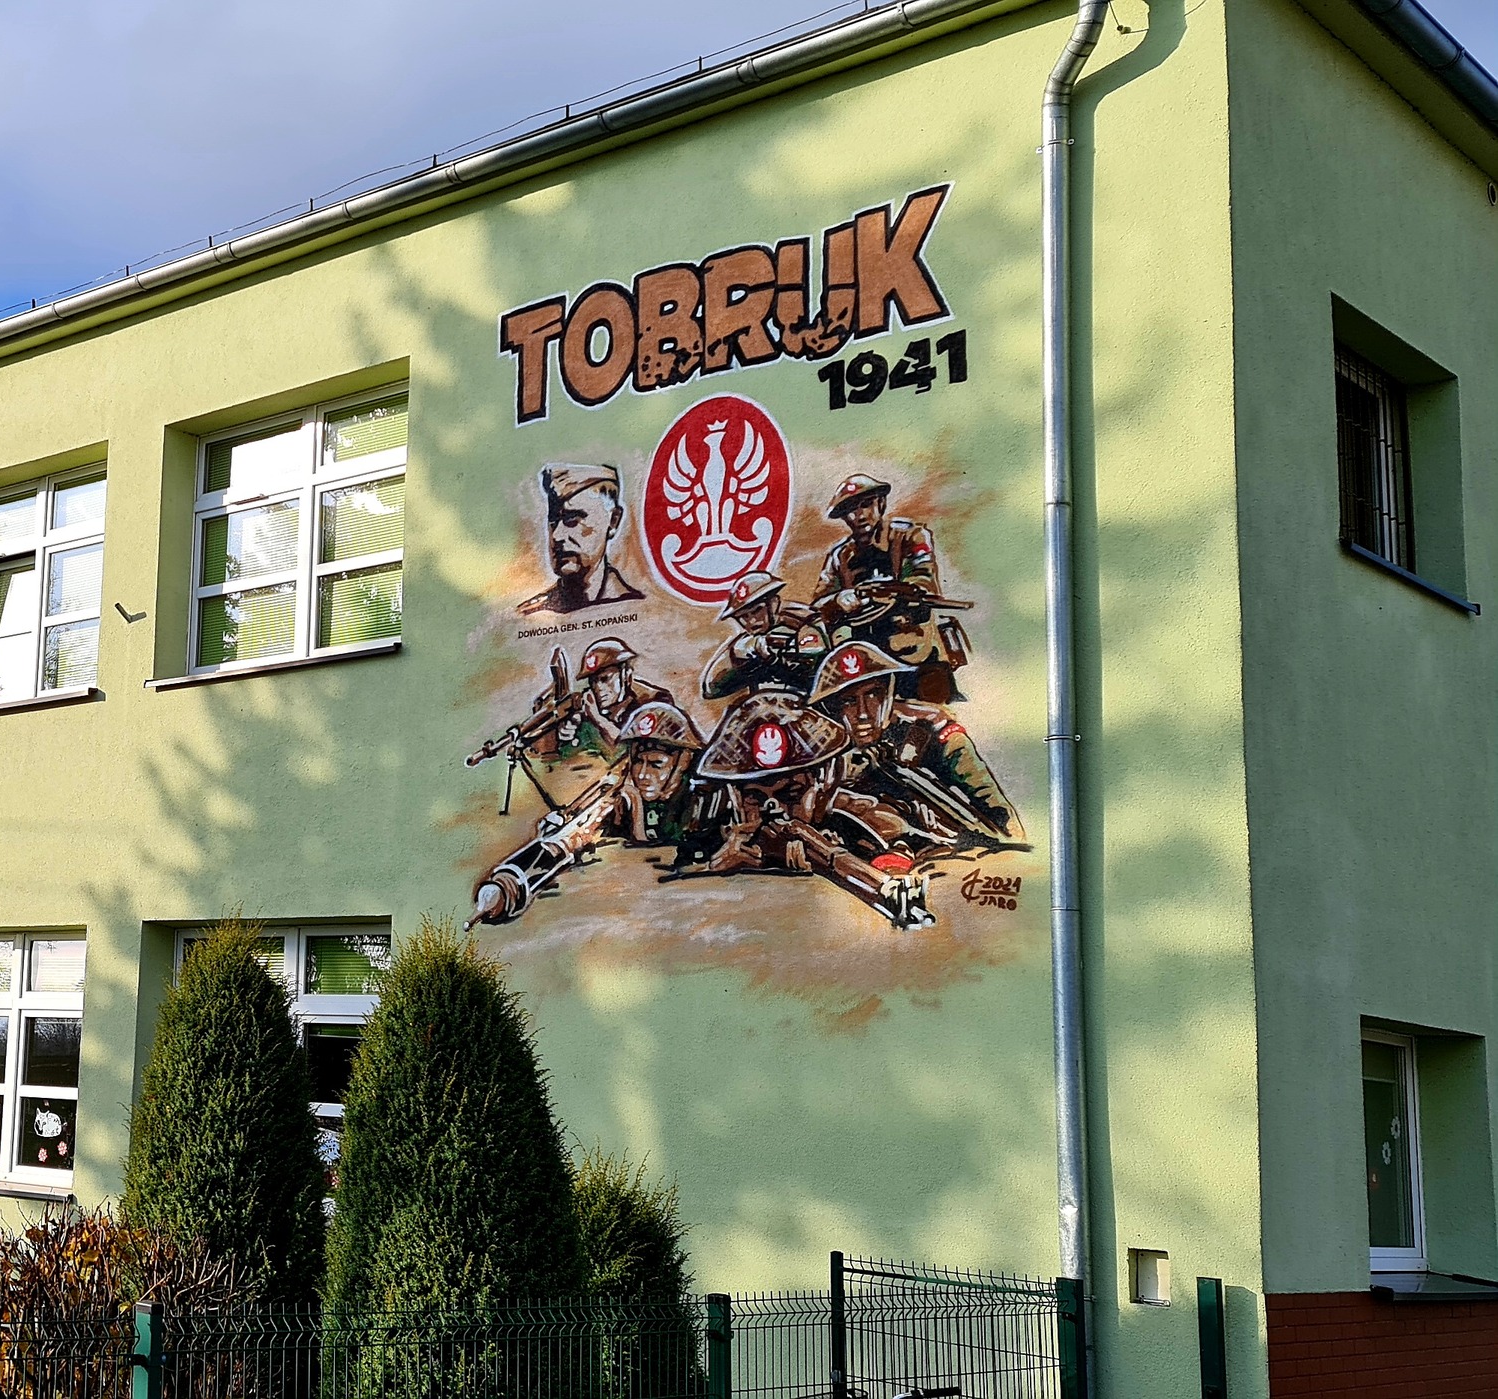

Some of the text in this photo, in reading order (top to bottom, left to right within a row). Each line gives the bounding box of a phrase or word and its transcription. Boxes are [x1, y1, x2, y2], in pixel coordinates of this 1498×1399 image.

[500, 182, 955, 427] TOBRUK
[818, 330, 968, 410] 1941
[518, 613, 638, 639] DOWÓDCA GEN. ST. KOPAŃSKI
[982, 876, 1021, 893] 2021
